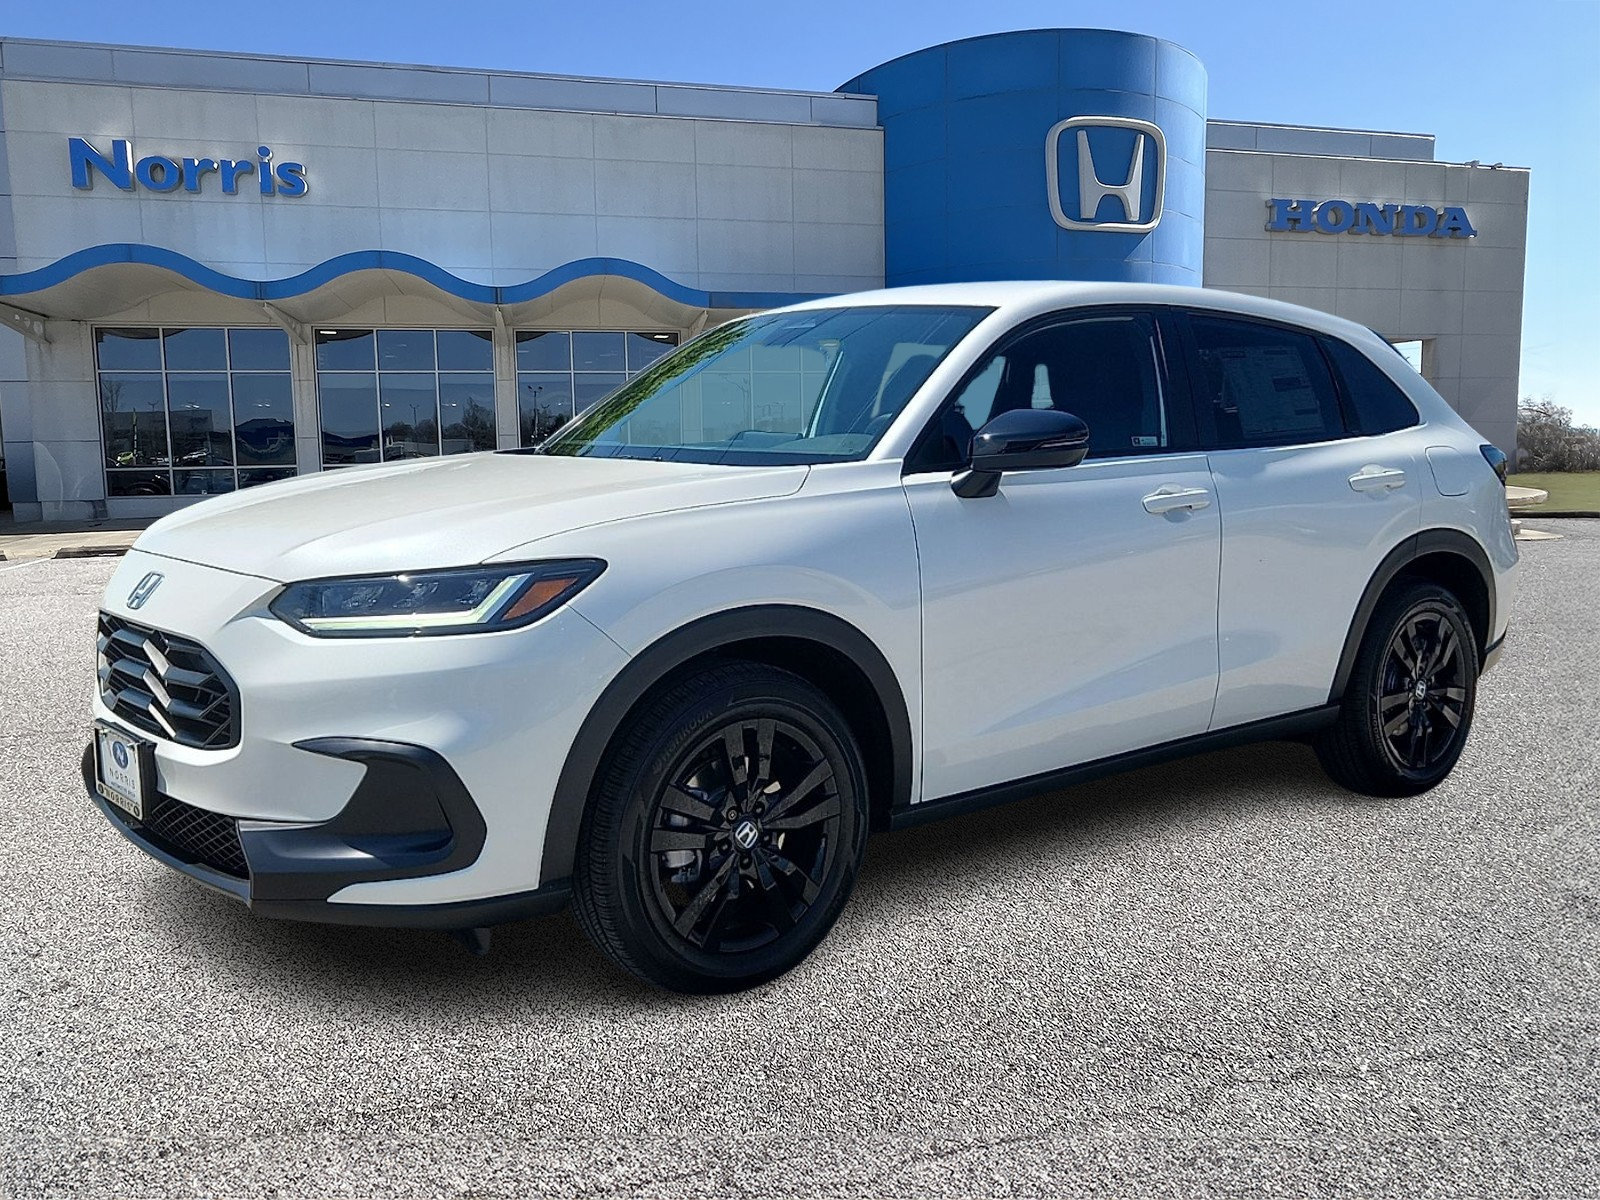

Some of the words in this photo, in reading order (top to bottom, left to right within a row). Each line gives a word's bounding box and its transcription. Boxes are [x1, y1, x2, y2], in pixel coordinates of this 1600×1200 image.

[68, 137, 309, 197] Norris
[1265, 198, 1478, 238] HONDA
[109, 767, 136, 790] NORRIS
